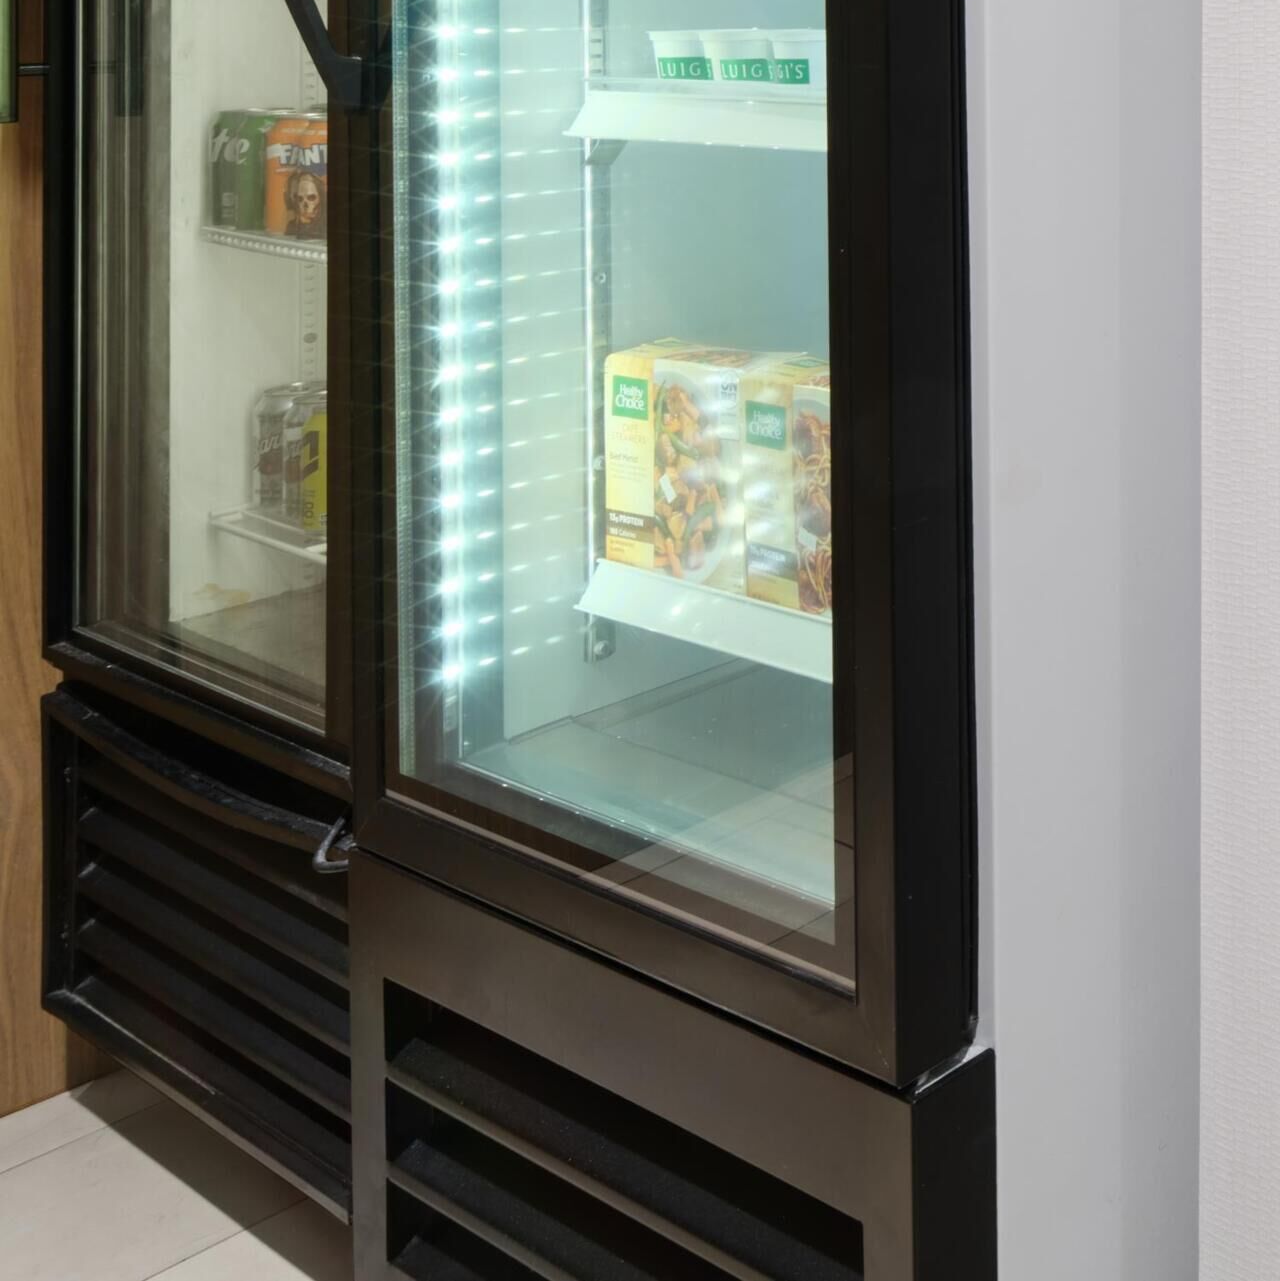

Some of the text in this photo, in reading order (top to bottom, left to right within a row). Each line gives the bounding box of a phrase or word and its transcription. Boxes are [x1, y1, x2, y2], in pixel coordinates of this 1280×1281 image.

[279, 143, 327, 166] FANT
[616, 394, 645, 412] Choice
[748, 420, 783, 440] Choice
